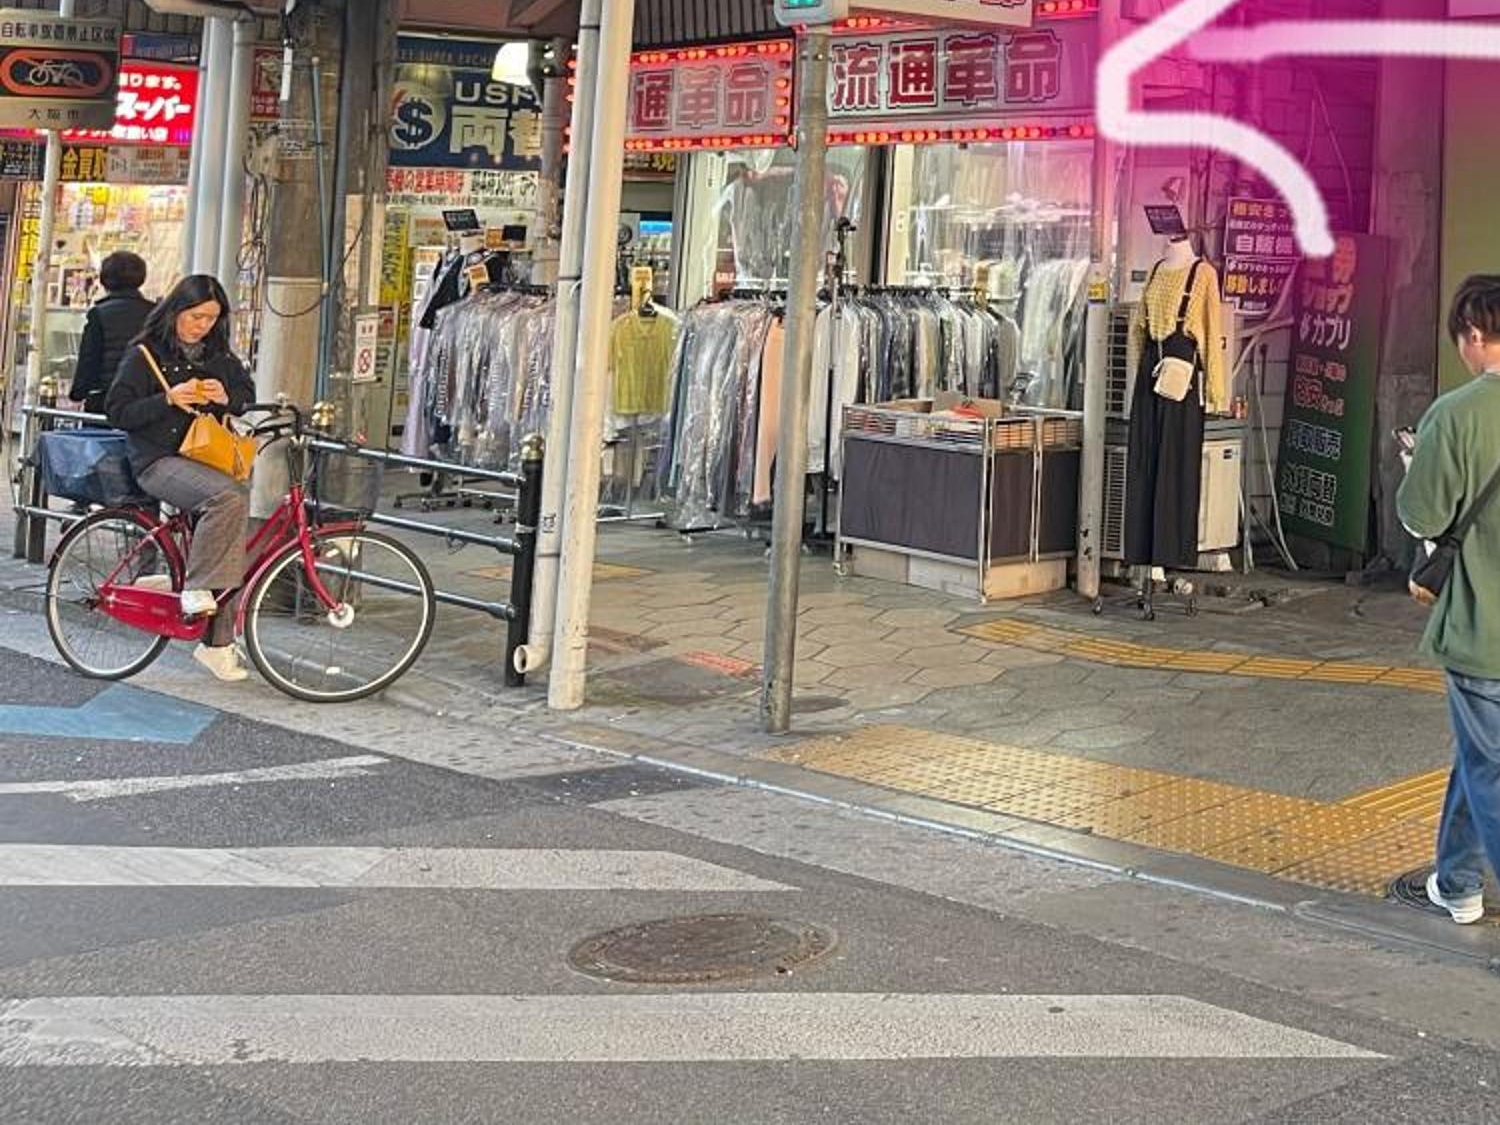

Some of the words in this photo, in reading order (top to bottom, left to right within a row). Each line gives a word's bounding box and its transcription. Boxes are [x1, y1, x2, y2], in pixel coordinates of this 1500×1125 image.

[632, 62, 770, 132] 通革命
[831, 28, 1063, 111] 流通革命
[28, 107, 81, 122] 大阪市
